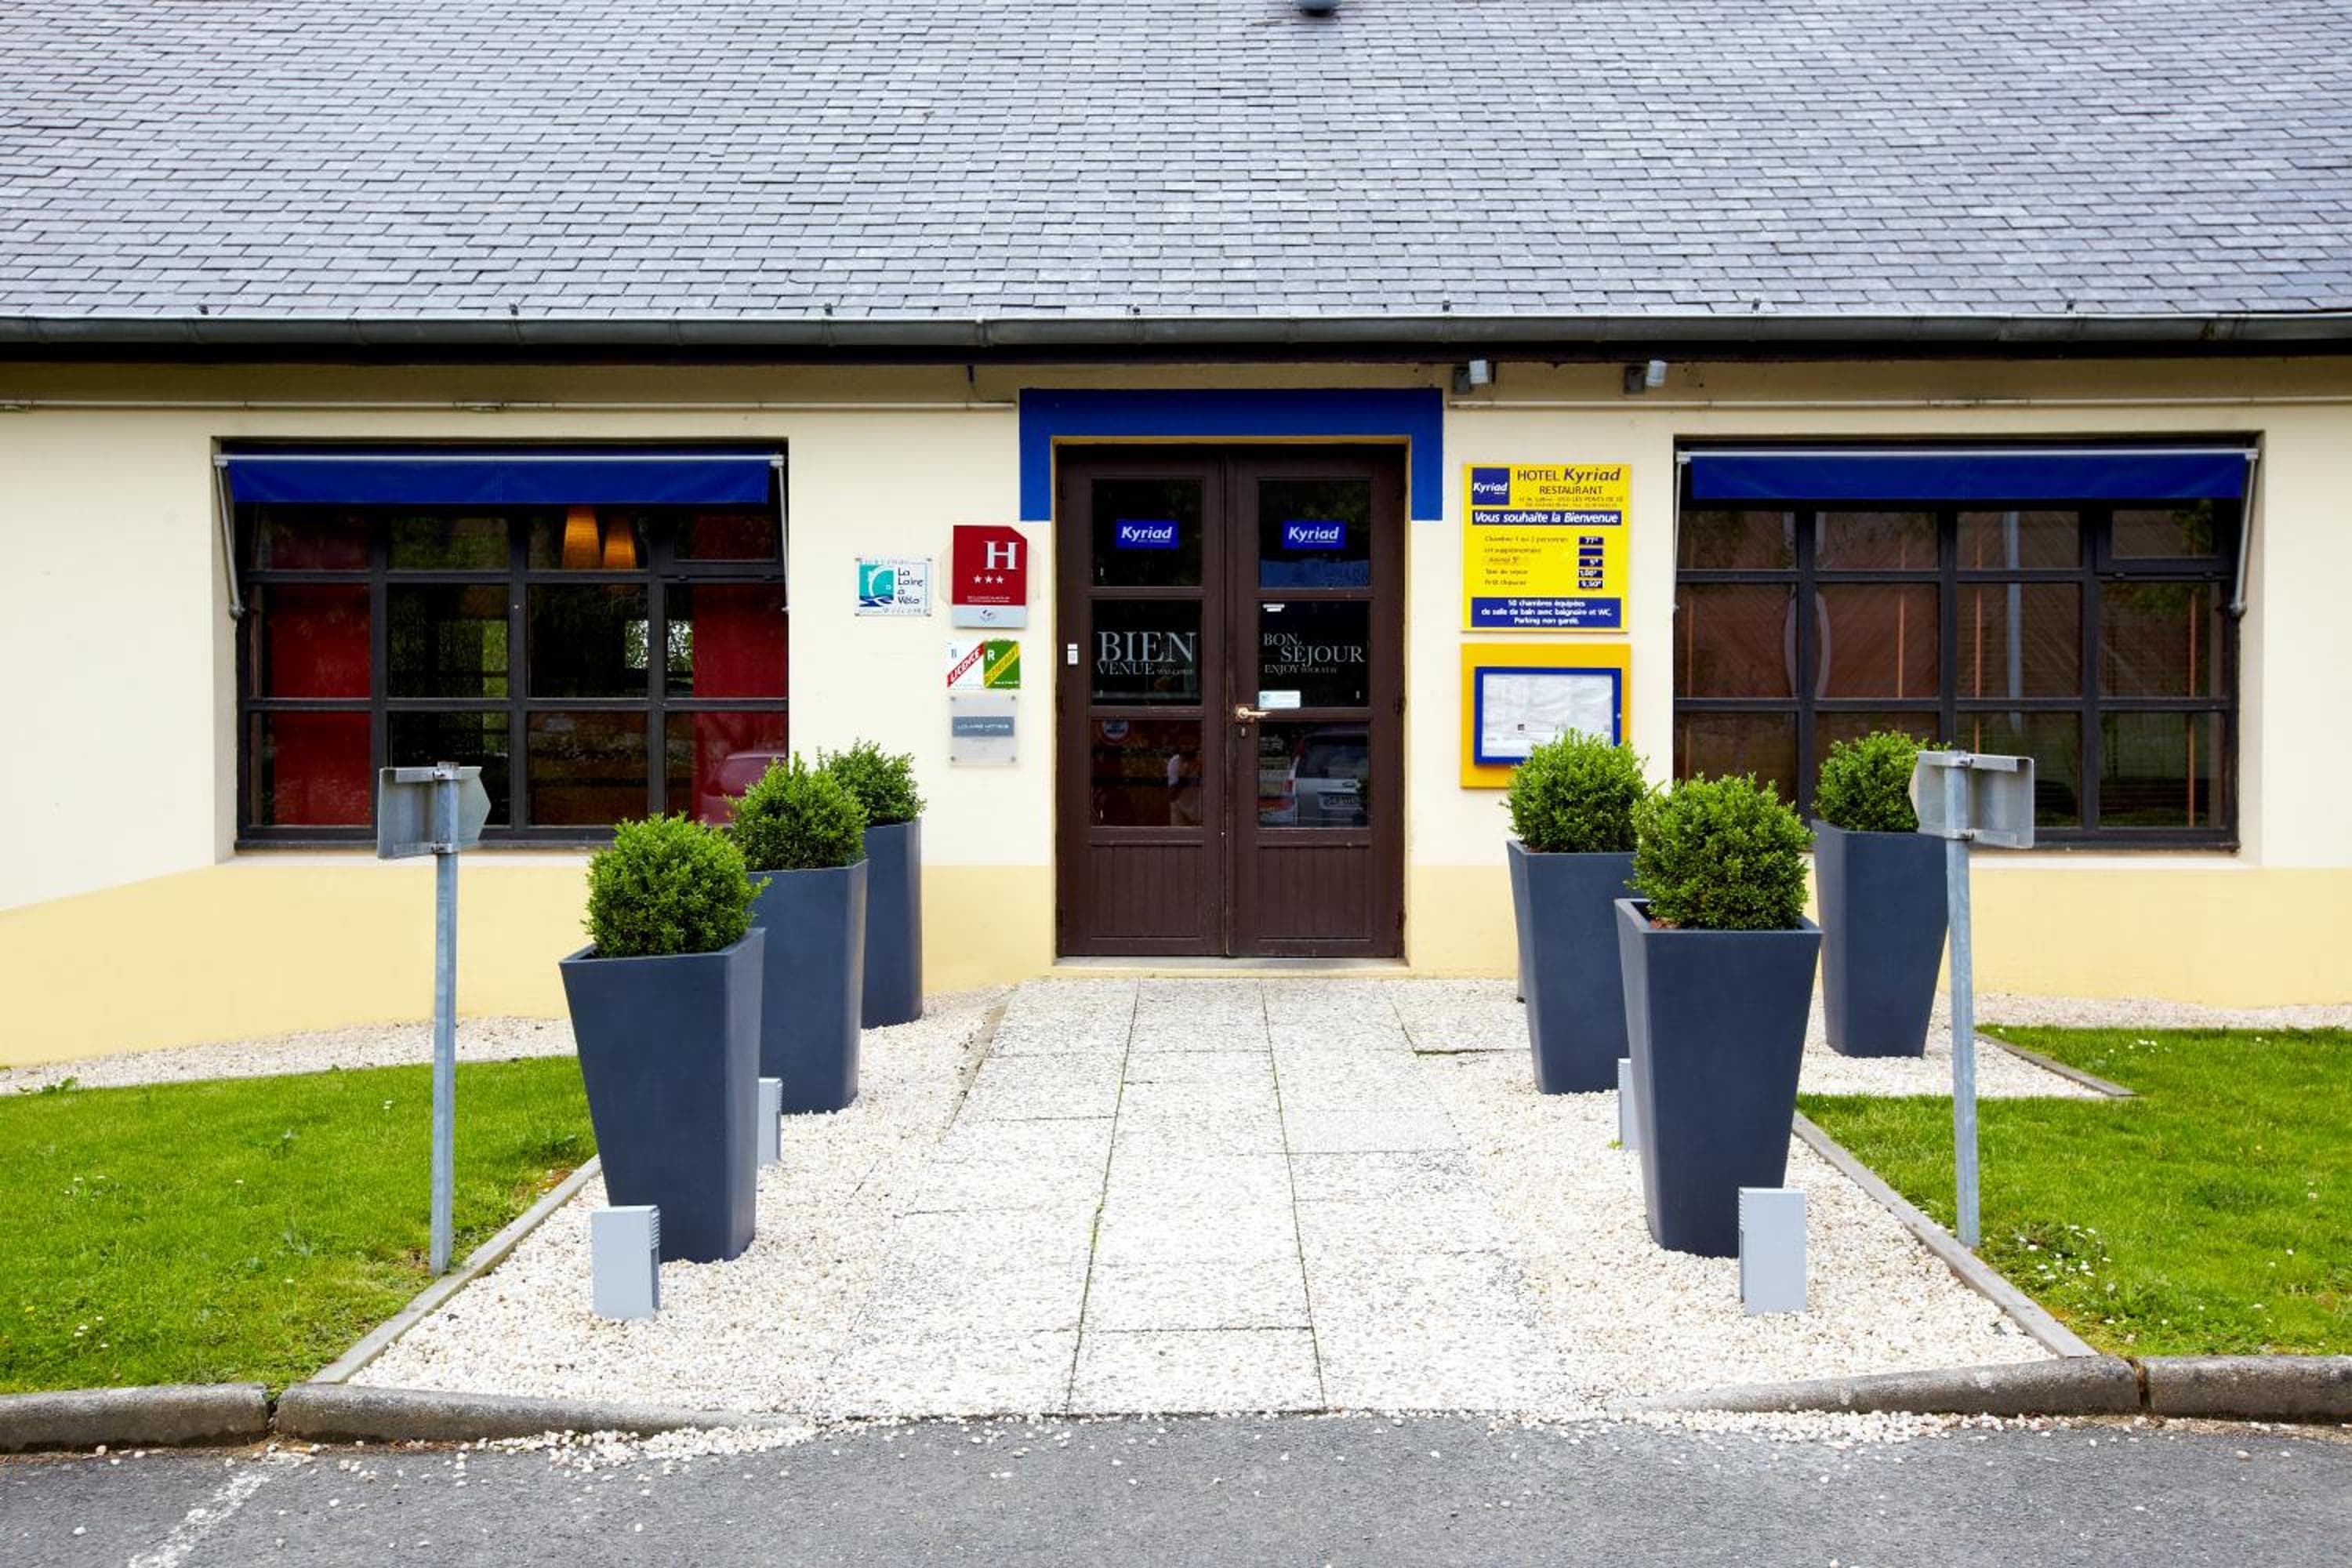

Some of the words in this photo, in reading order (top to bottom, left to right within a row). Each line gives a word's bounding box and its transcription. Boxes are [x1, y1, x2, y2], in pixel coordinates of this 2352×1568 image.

[1517, 470, 1559, 481] HOTEL
[1564, 467, 1621, 485] Kyriad
[1472, 482, 1508, 493] Kyriad
[1539, 485, 1603, 495] RESTAURANT
[1474, 512, 1500, 523] Vous
[1503, 511, 1548, 523] souhaite
[1552, 511, 1561, 523] la
[1564, 511, 1618, 523] Bienvenue
[1121, 525, 1173, 540] Kyriad
[1288, 525, 1340, 540] Kyriad
[985, 540, 1020, 570] H
[898, 567, 910, 576] La
[898, 577, 924, 587] Loire
[898, 595, 920, 604] Vélo
[1514, 617, 1541, 626] Parking
[1263, 633, 1298, 646] BON
[1098, 631, 1197, 662] BIEN
[987, 650, 995, 661] R
[1280, 640, 1365, 666] SÉJOUR
[1098, 661, 1155, 675] VENUE
[1264, 664, 1299, 676] ENJOY
